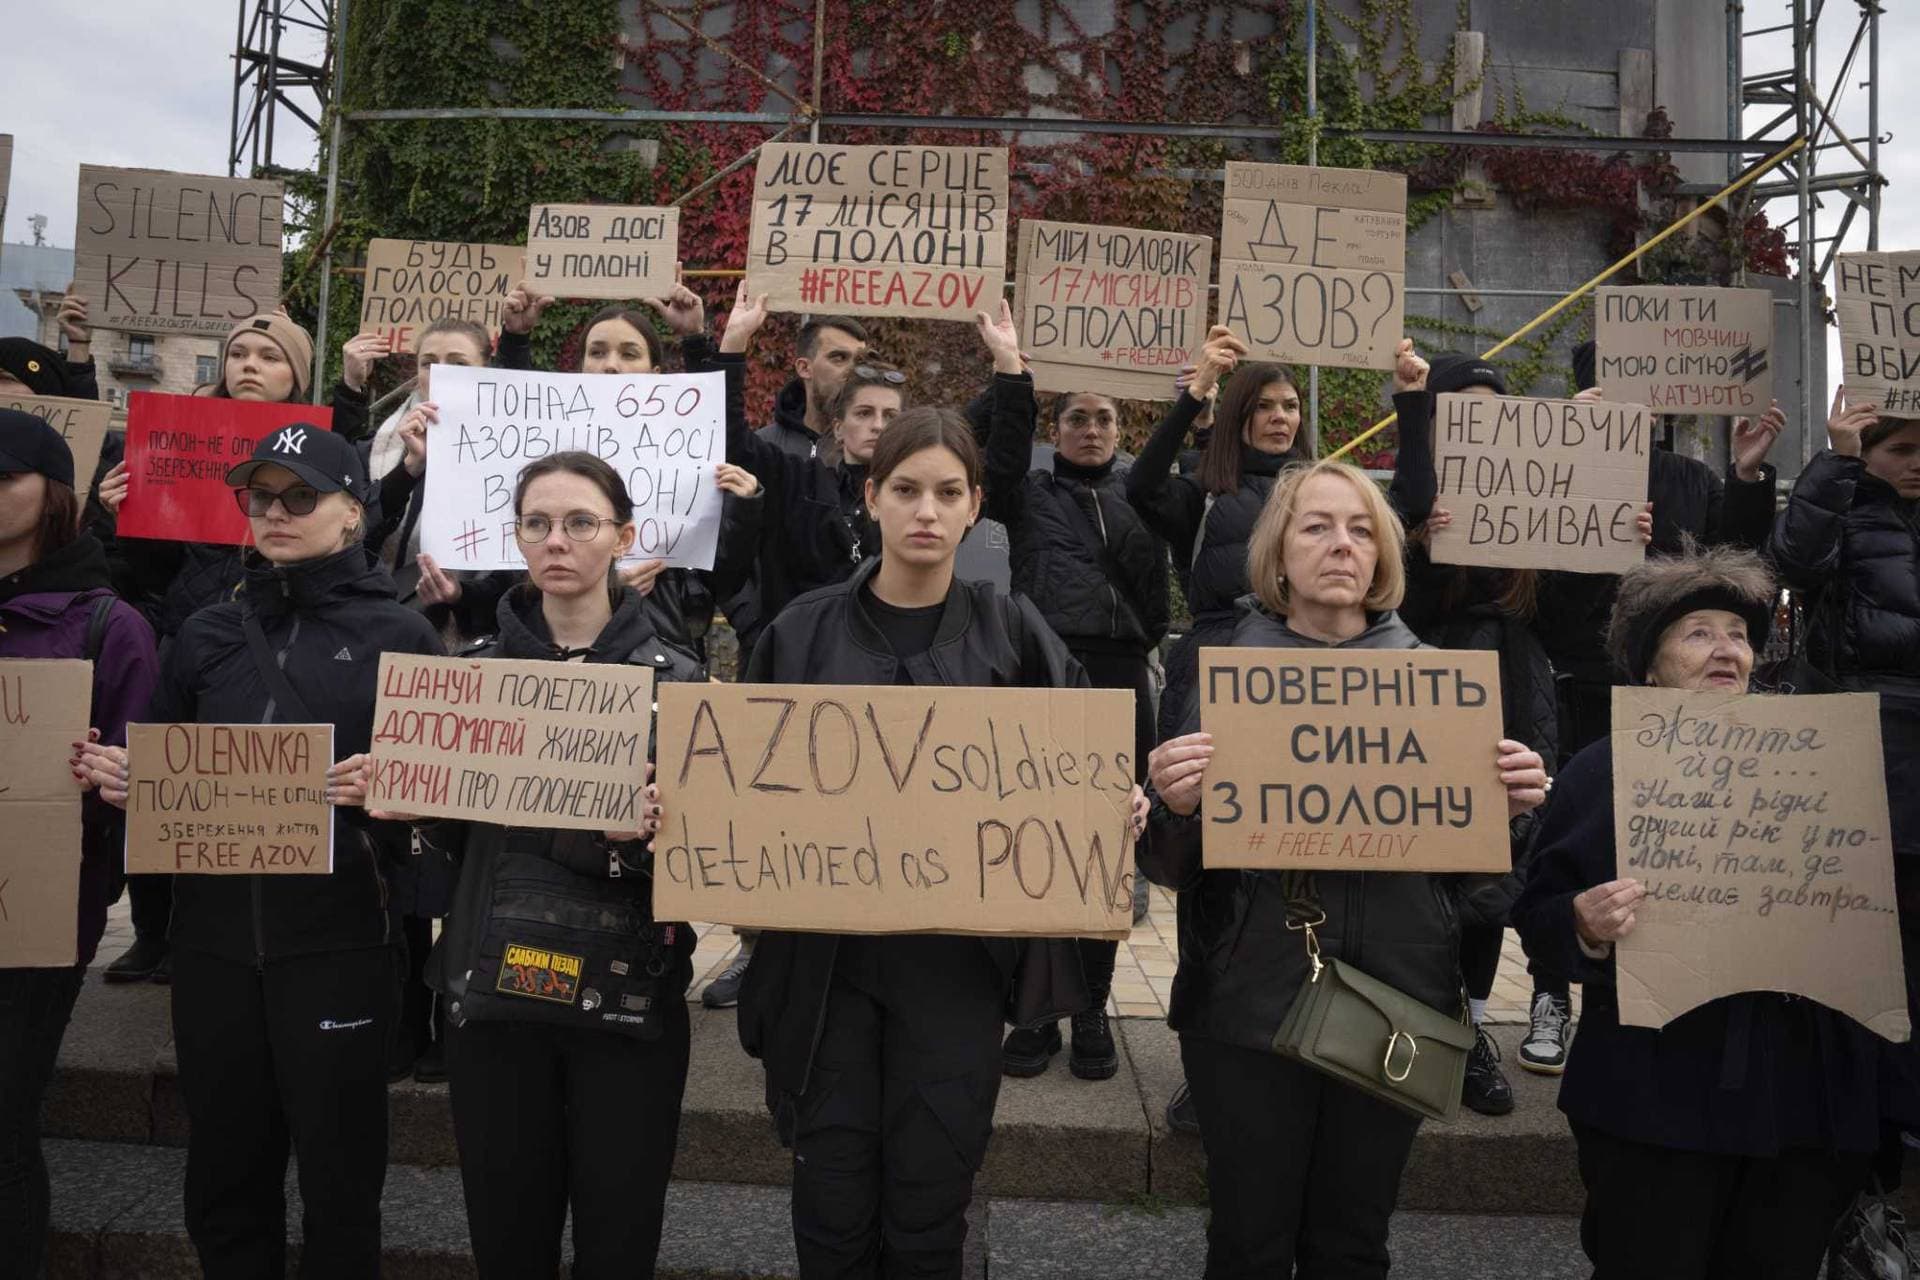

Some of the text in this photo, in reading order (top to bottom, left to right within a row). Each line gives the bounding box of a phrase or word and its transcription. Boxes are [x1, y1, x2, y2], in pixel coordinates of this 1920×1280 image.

[765, 151, 993, 194] МОЄ СЕРЦЕ
[1232, 169, 1264, 190] 500
[88, 182, 283, 249] SILENCE
[768, 190, 996, 233] 17 МІСЯЦІВ
[407, 240, 496, 270] БУДЬ
[765, 230, 984, 269] В ПОЛОНІ
[1036, 227, 1201, 277] МІЙ ЧОЛОВІК
[1247, 199, 1341, 270] ДЕ
[103, 253, 260, 320] KILLS
[372, 267, 508, 297] ГОЛОСОМ
[800, 268, 985, 309] #FREEAZOV
[1039, 266, 1083, 302] 17
[1841, 261, 1886, 298] НЕ
[364, 296, 504, 327] ПОЛОНЕН
[1032, 304, 1186, 349] В ПОЛОНІ
[1225, 272, 1395, 352] АЗОВ?
[1605, 294, 1716, 323] ПОКИ ТИ
[1602, 355, 1657, 379] МОЮ
[478, 382, 701, 421] ПОНАД 650
[1651, 384, 1754, 409] КАТУЮТЬ
[633, 420, 717, 462] ДОСІ
[1447, 400, 1484, 447] НЕ
[1440, 455, 1574, 499] ПОЛОН
[1469, 502, 1633, 548] ВБИВАЄ
[383, 663, 642, 714] ШАНУЙ ПОЛЕГЛИХ
[1208, 661, 1488, 708] ПОВЕРНІТЬ
[164, 724, 310, 776] OLENIVKA
[374, 709, 639, 766] ДОПОМАГАЙ ЖИВИМ
[678, 697, 936, 797] AZOV
[1290, 724, 1428, 765] СИНА
[1637, 704, 1826, 755] Життя
[372, 757, 642, 823] КРИЧИ ПРО ПОЛОНЕНИХ
[1210, 781, 1473, 829] З ПОЛОНУ
[1632, 778, 1829, 823] Наші рідні
[158, 823, 265, 842] ЗБЕРЕЖЕННЯ
[1729, 818, 1783, 848] рік
[175, 842, 316, 870] FREE AZOV
[900, 846, 950, 888] as
[975, 814, 1136, 914] POWs
[1804, 854, 1843, 883] де
